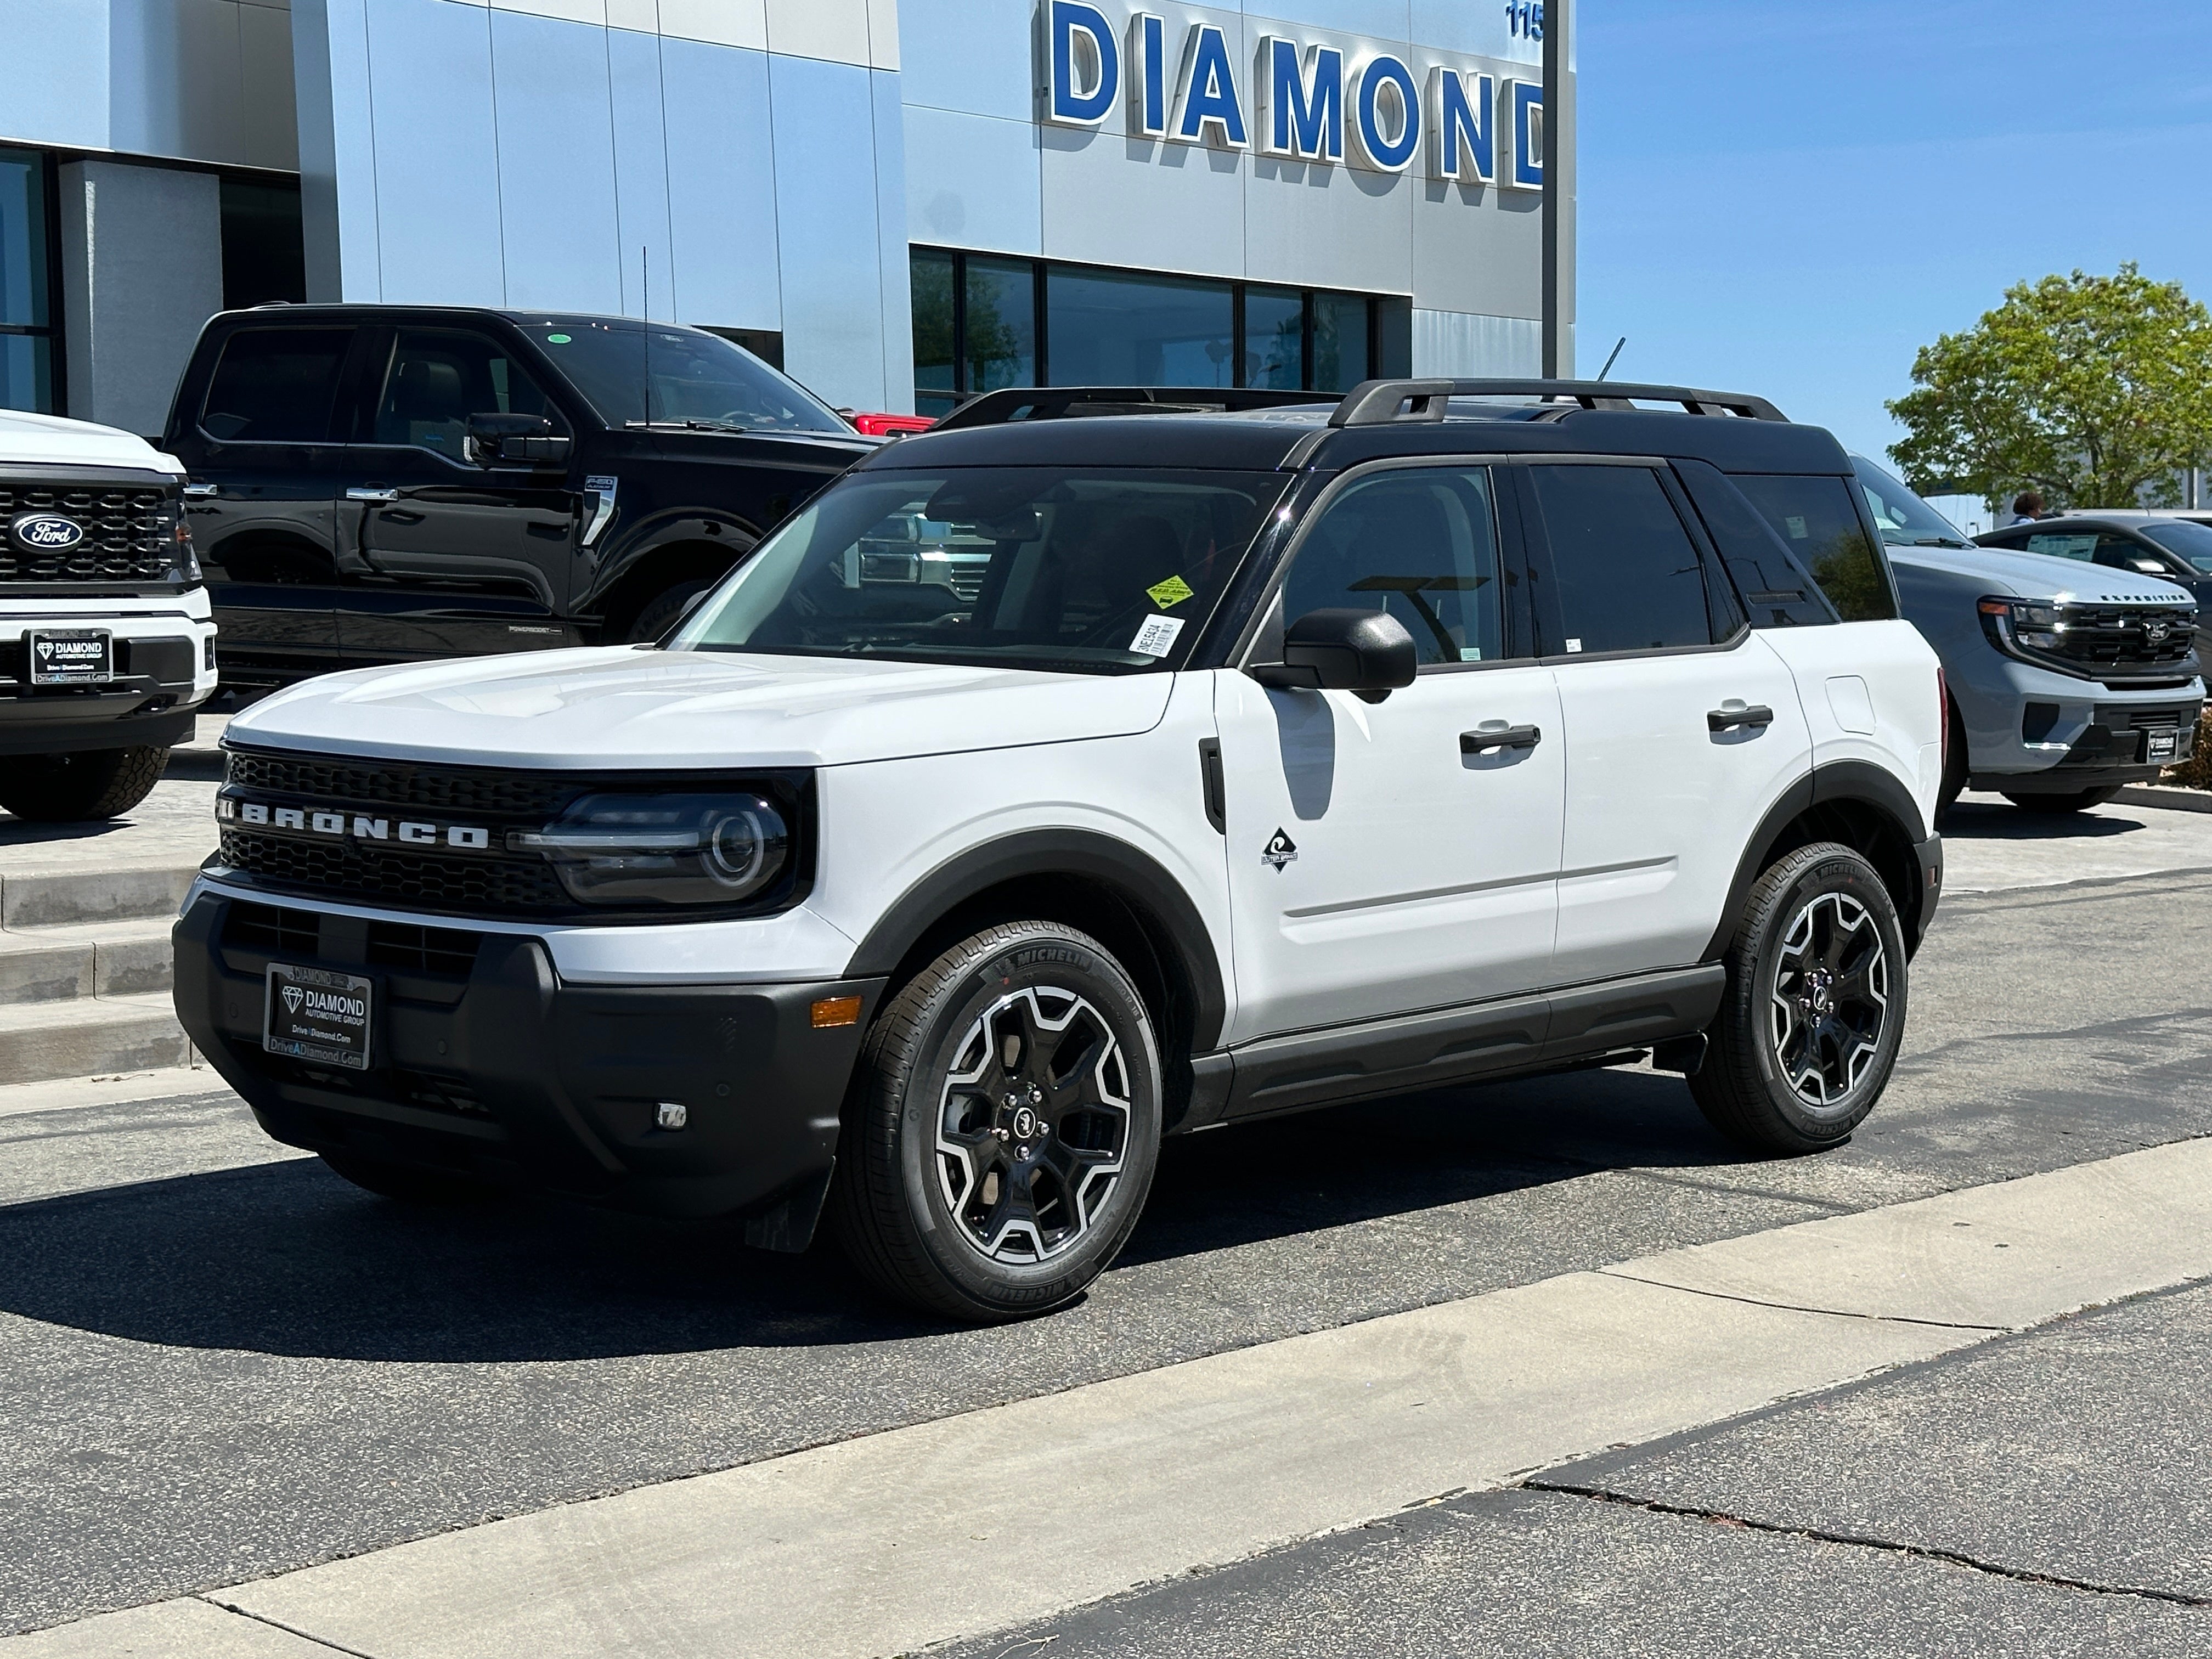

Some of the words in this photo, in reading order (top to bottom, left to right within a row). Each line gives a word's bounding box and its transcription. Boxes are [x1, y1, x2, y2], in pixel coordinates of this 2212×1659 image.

[1049, 0, 1542, 190] DIAMOND
[32, 522, 71, 542] Ford
[55, 642, 102, 653] DIAMOND
[242, 803, 489, 849] BRONCO
[1018, 949, 1091, 967] MICHELIN
[295, 967, 331, 984] DIAMOND
[306, 991, 364, 1016] DIAMOND
[306, 1008, 342, 1023] AUTOMOTIVE
[343, 1015, 365, 1026] GROUP
[270, 1039, 362, 1066] DriveADiamond.Com
